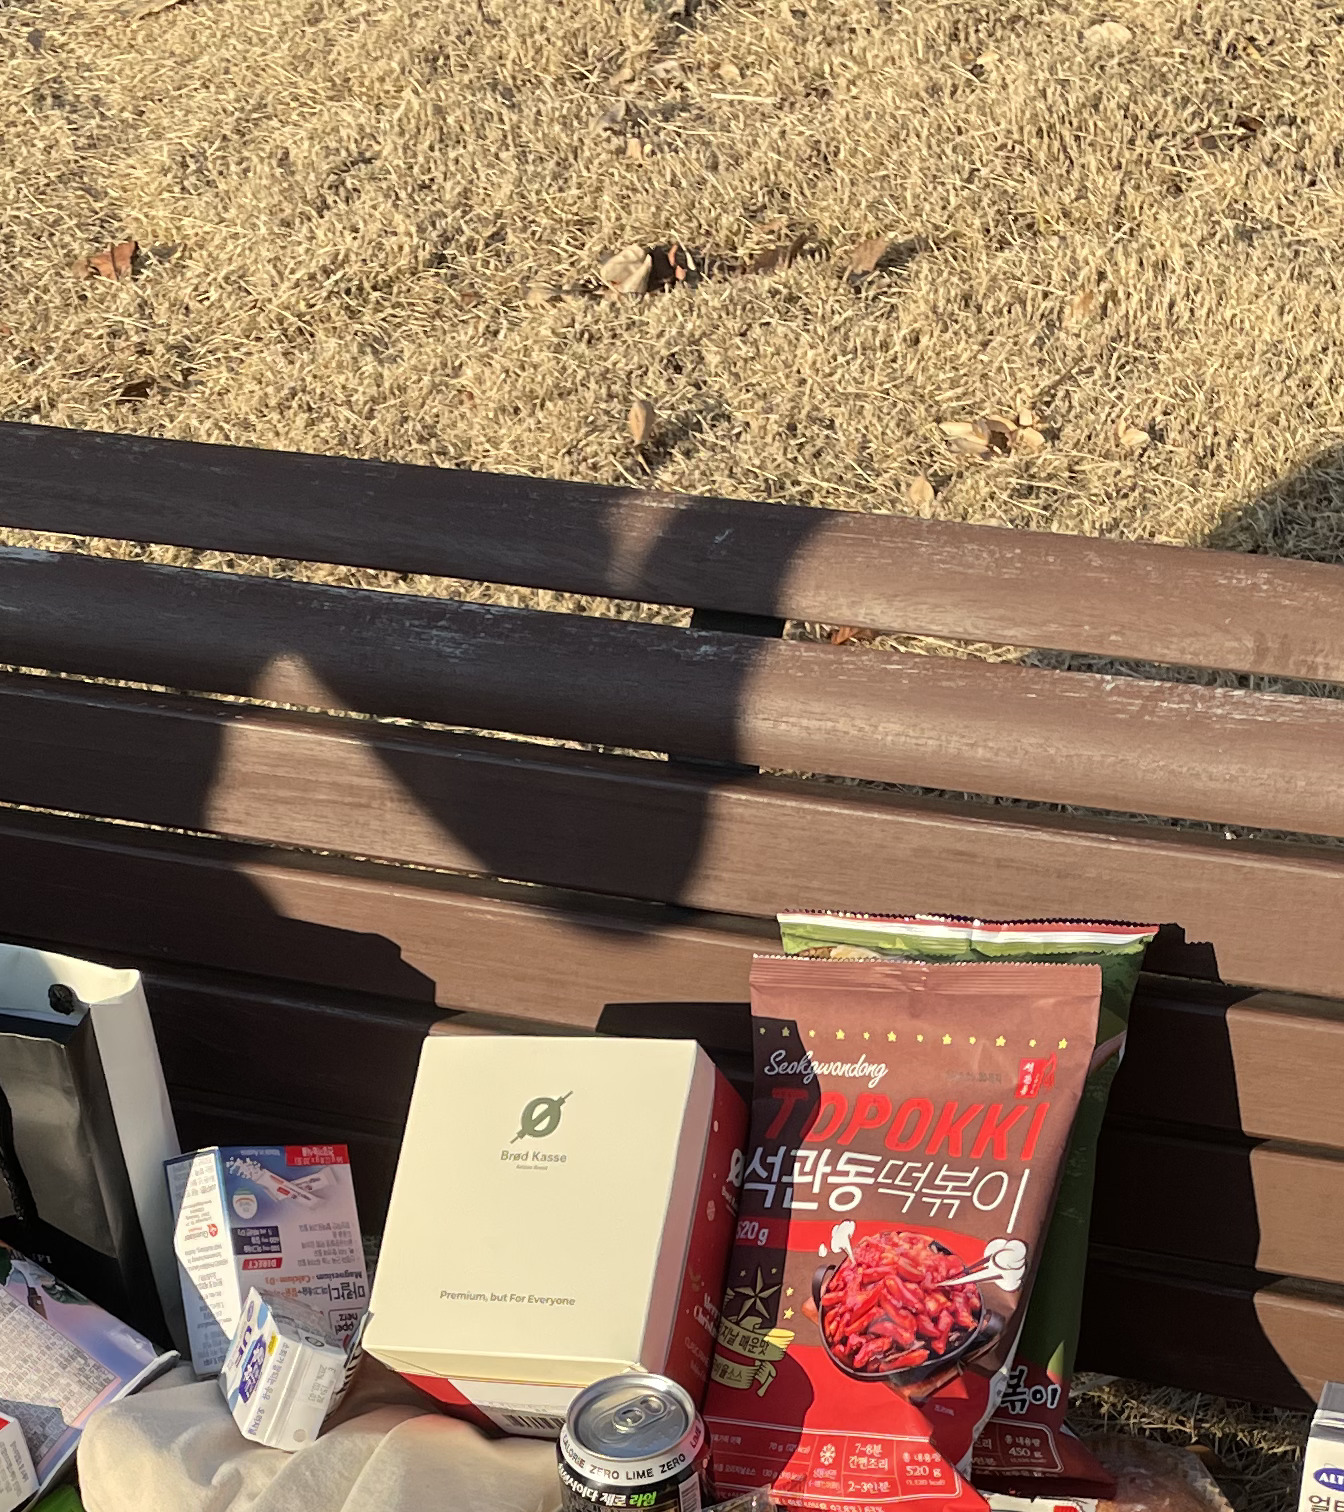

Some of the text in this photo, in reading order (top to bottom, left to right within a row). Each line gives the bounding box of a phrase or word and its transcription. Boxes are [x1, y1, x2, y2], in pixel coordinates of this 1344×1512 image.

[764, 1049, 888, 1088] Seokgwandong
[764, 1087, 1051, 1162] TOPOKKI
[500, 1150, 567, 1163] Brød Kasse
[316, 1269, 362, 1282] Magnesium
[440, 1290, 576, 1307] Premium, but For Everyone
[589, 1464, 620, 1479] ZERO
[626, 1469, 654, 1480] LIME
[660, 1453, 686, 1474] ZERO
